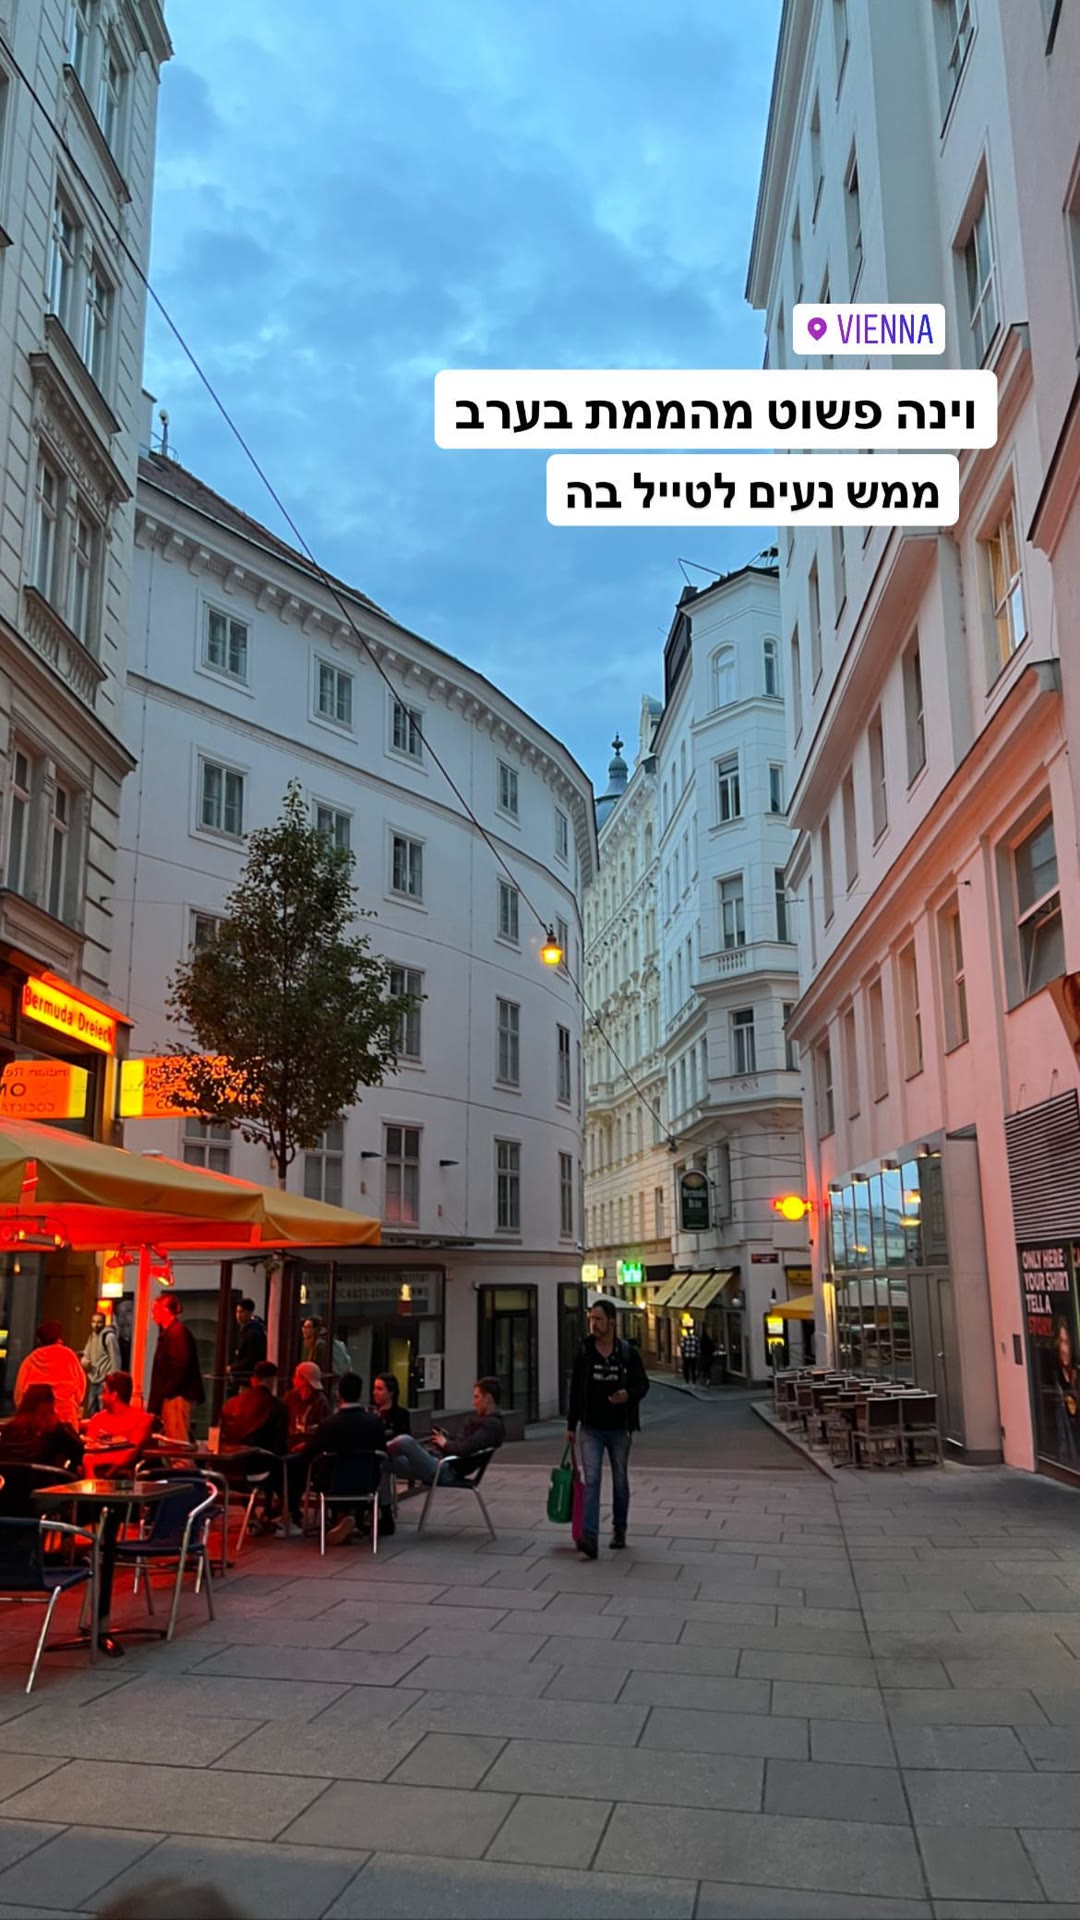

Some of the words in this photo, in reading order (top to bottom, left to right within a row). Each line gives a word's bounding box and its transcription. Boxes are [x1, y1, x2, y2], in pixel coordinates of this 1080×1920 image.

[24, 985, 74, 1026] Bermuda
[1022, 1250, 1041, 1269] ONLY
[1043, 1248, 1065, 1268] HERE
[1024, 1272, 1046, 1291] YOUR
[1046, 1271, 1070, 1291] SHIRT
[1026, 1293, 1045, 1313] TELL
[1045, 1294, 1053, 1314] A
